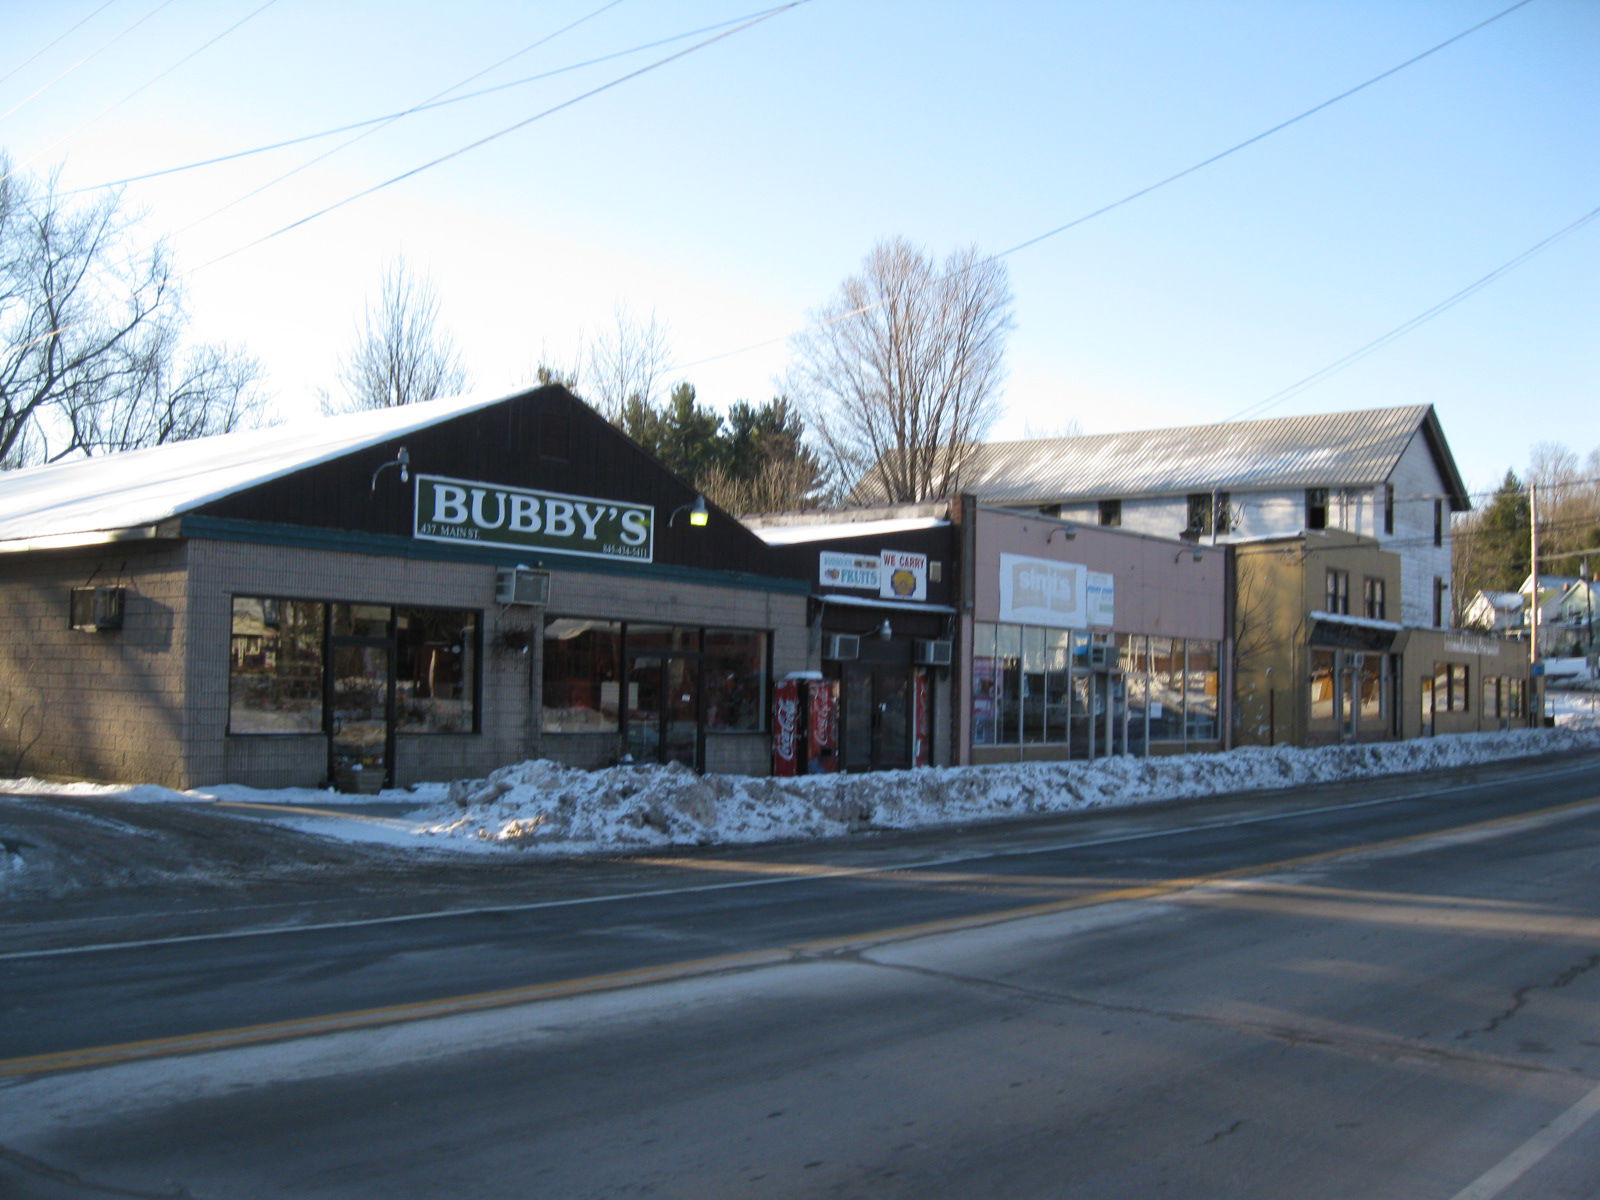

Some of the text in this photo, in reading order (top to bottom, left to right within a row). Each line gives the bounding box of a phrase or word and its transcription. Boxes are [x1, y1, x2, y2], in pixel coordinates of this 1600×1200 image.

[432, 483, 647, 546] BUBBY'S
[440, 525, 467, 538] MAIN
[883, 553, 896, 566] WE
[899, 555, 925, 569] CARRY
